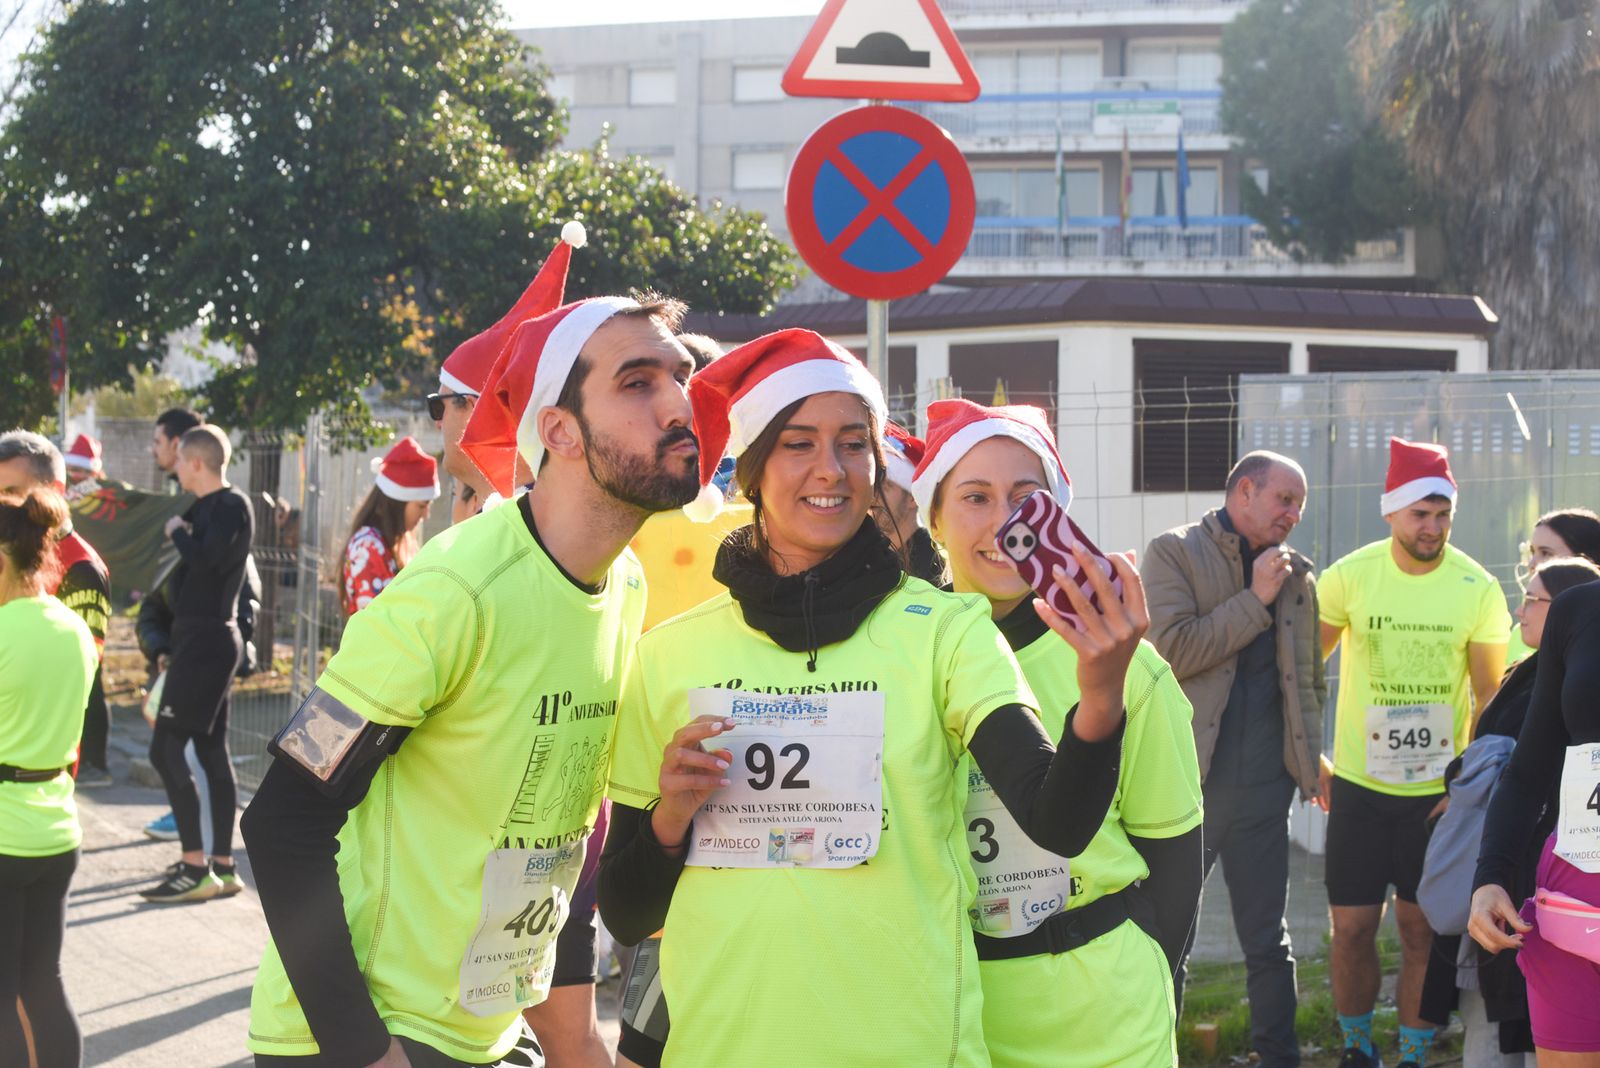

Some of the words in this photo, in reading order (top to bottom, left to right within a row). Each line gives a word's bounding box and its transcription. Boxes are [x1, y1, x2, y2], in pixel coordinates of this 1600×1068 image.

[1391, 624, 1453, 632] ANIVERSARIO
[532, 691, 572, 726] 41º
[567, 700, 618, 723] ANIVERSARI
[1388, 727, 1431, 749] 549
[744, 742, 810, 791] 92
[719, 804, 739, 813] SAN
[741, 803, 803, 814] SILVESTRE
[805, 802, 875, 813] CORDOBESA
[738, 815, 781, 824] ESTEFANÍA
[782, 814, 812, 824] AYLLÓN
[813, 816, 843, 824] ARJONA
[713, 838, 760, 849] IMDECO
[834, 838, 863, 848] GCC
[995, 867, 1065, 883] CORDOBESA
[1001, 884, 1032, 894] ARJONA
[1030, 900, 1056, 914] GCC
[487, 952, 504, 962] SAN
[475, 982, 511, 998] IMDECO
